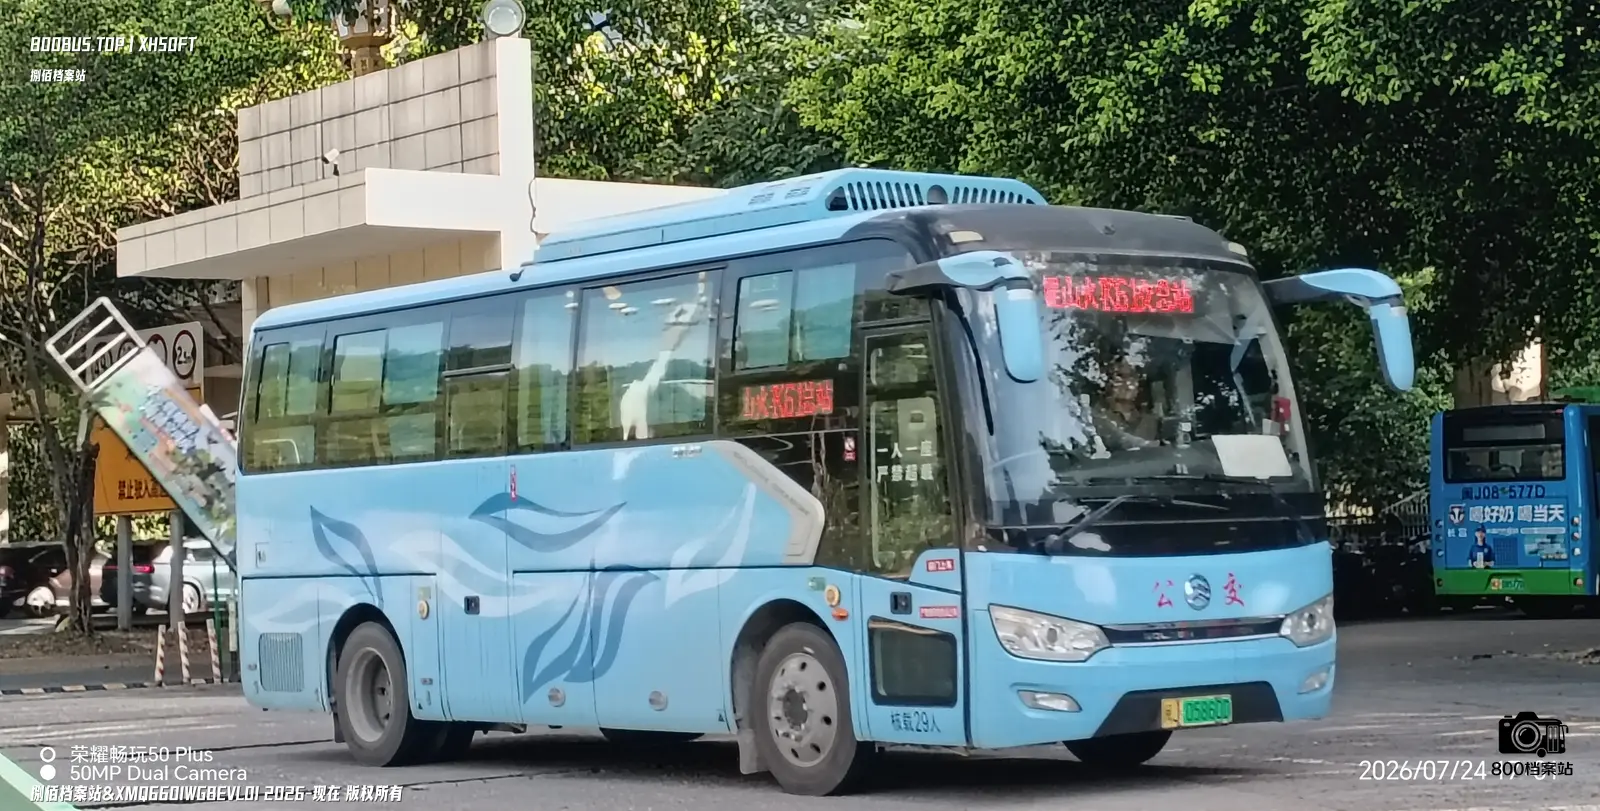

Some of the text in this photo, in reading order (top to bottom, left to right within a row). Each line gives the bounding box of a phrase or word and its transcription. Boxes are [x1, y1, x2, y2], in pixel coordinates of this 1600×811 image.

[1469, 503, 1565, 523] 喝好奶 喝当天
[891, 710, 942, 733] 核载29人
